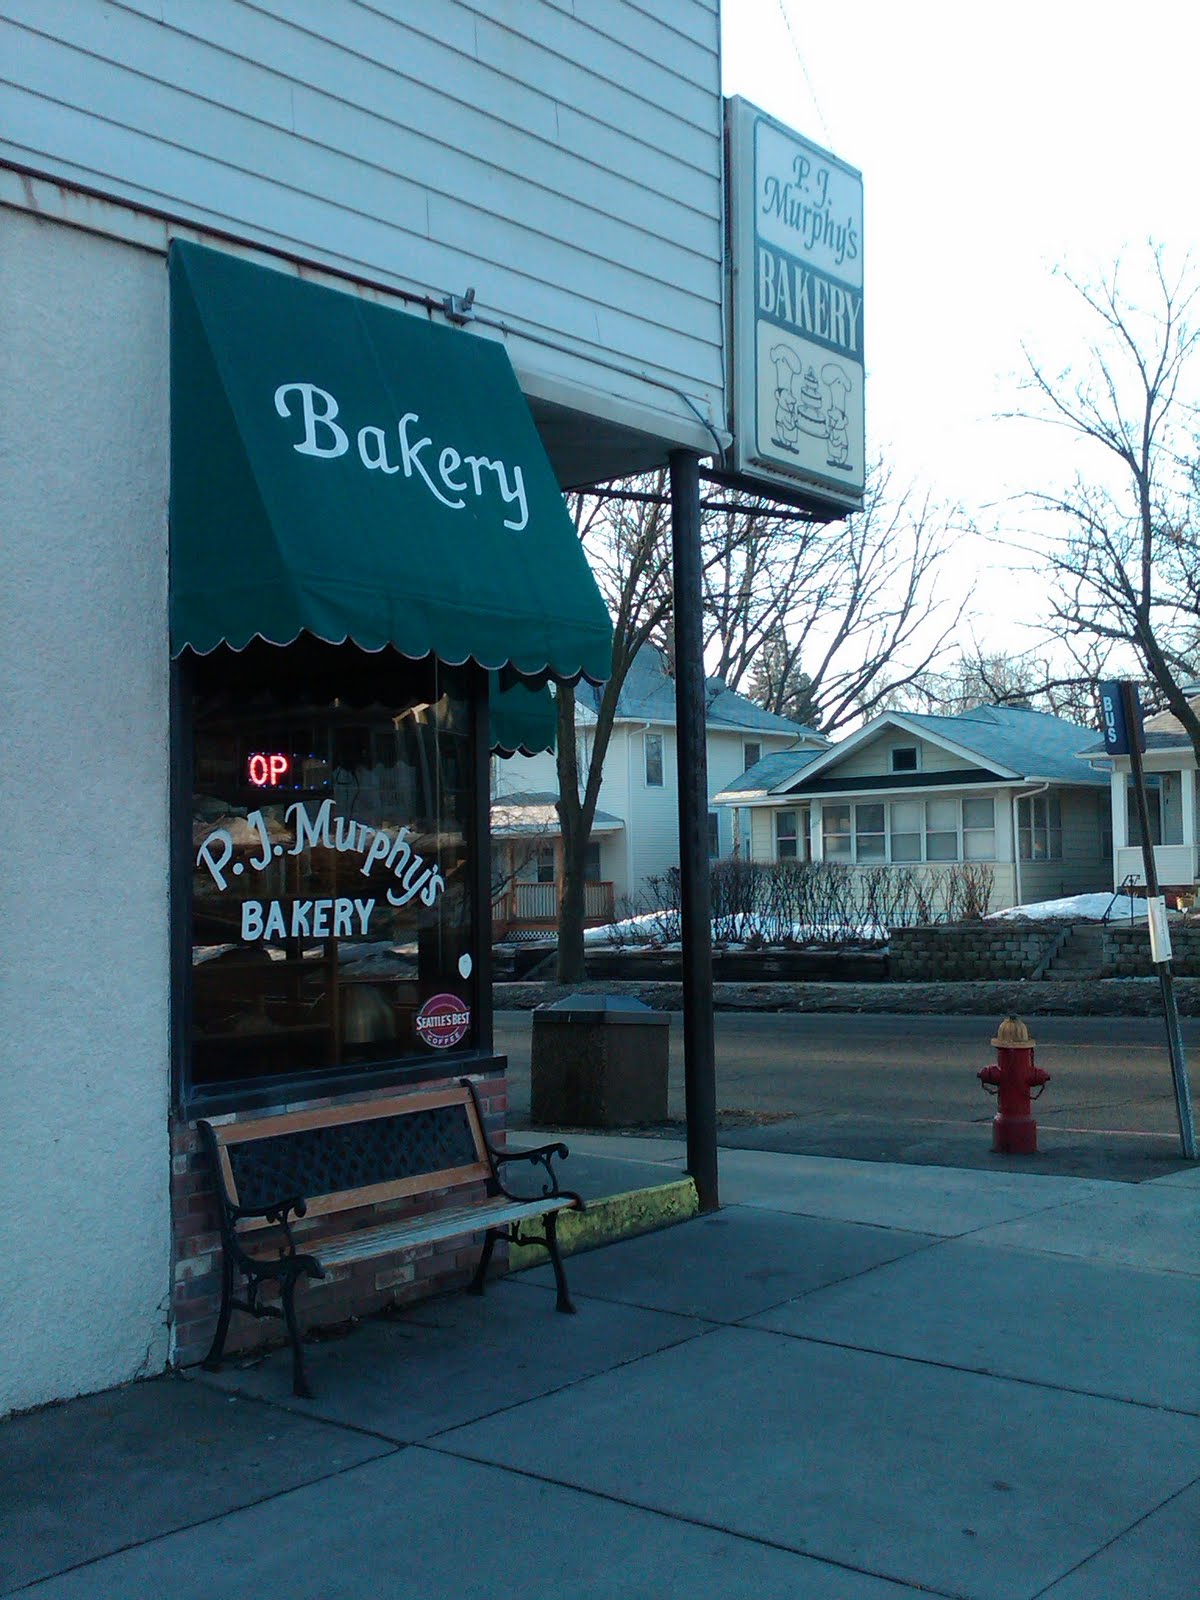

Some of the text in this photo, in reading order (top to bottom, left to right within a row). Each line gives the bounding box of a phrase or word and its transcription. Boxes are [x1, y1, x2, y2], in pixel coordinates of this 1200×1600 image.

[762, 175, 858, 266] Murphy's
[758, 246, 862, 353] BAKERY
[273, 382, 529, 532] Bakery
[1103, 696, 1117, 743] BUS
[285, 798, 445, 907] Murphy's
[240, 898, 376, 942] BAKERY
[416, 1011, 470, 1031] SEATTLE'S BEST
[426, 1032, 460, 1045] COFFEE
